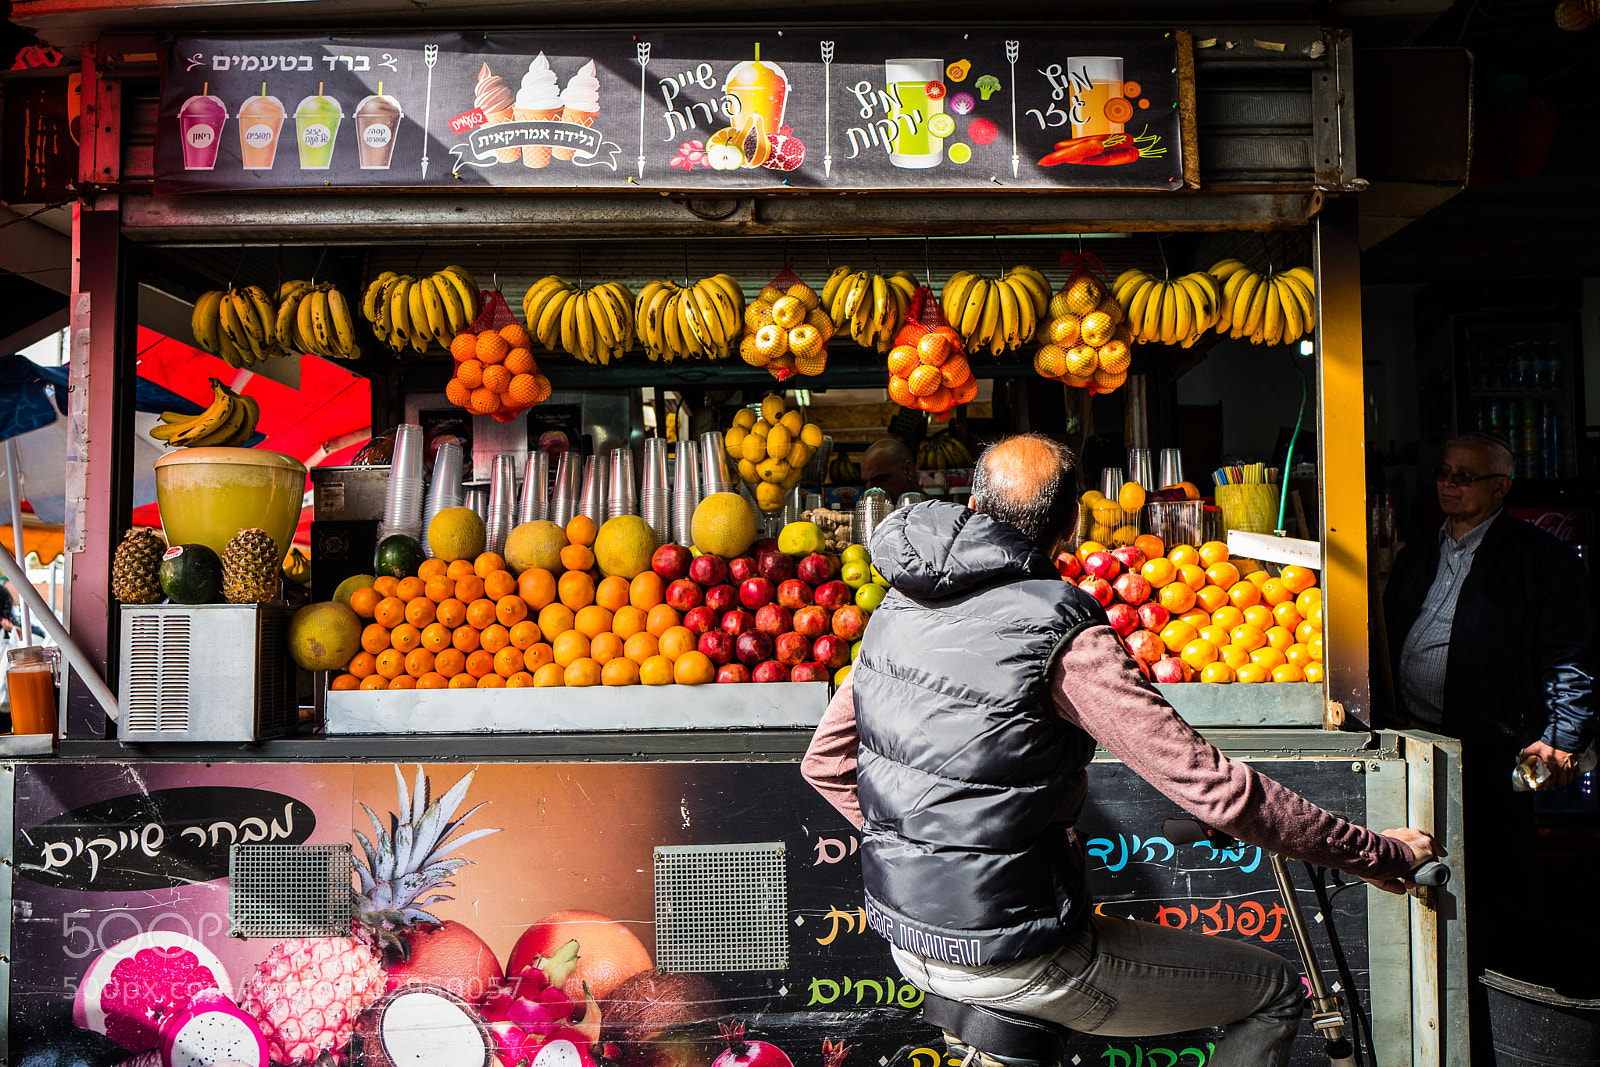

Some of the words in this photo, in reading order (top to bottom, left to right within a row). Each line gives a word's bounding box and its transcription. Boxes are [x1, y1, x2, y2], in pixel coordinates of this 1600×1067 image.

[212, 53, 314, 72] בטעמים
[322, 53, 371, 72] ברד
[658, 63, 717, 111] שייק
[846, 80, 903, 120] מיץ
[1037, 63, 1094, 101] מיץ
[451, 113, 484, 132] בטעמים
[663, 95, 742, 142] פירות
[1025, 97, 1091, 130] גזר
[477, 128, 551, 148] אמריקאית
[552, 129, 595, 148] גלידה
[846, 108, 924, 159] ירקות
[180, 802, 293, 848] מבחר
[41, 822, 164, 882] שייקים
[807, 975, 925, 1010] פוחים
